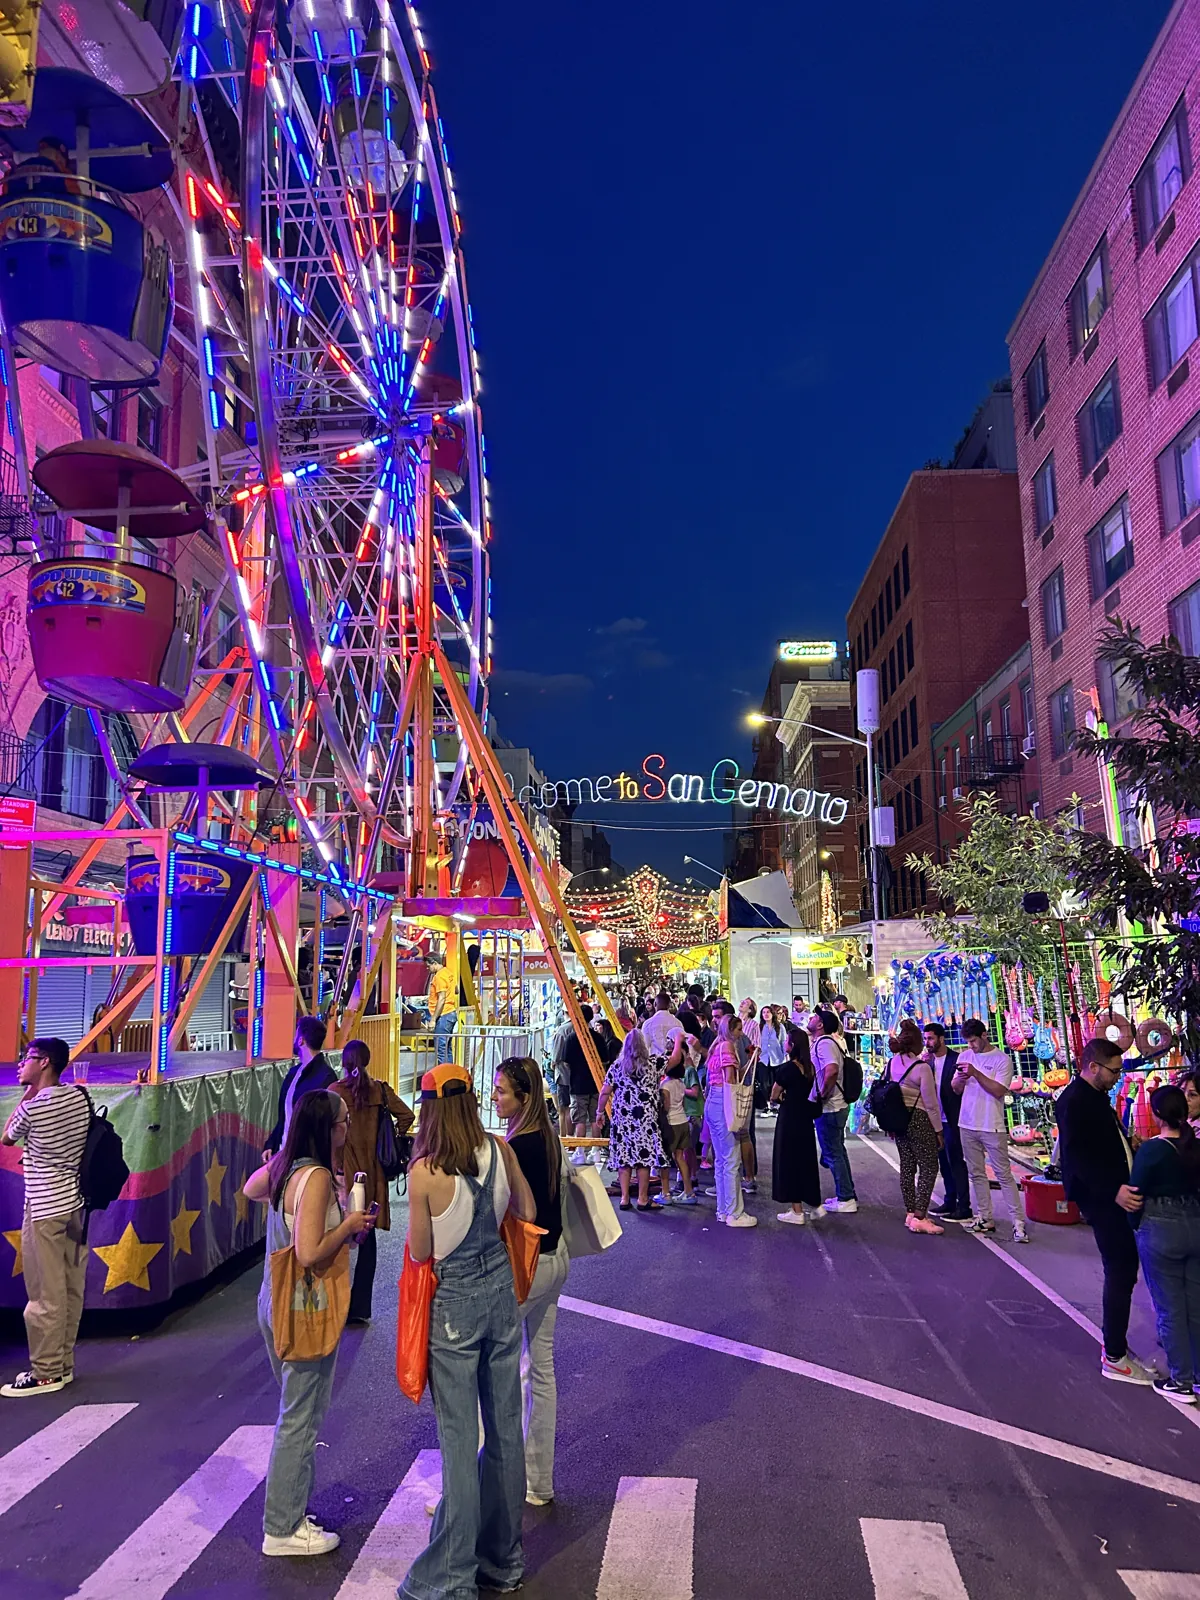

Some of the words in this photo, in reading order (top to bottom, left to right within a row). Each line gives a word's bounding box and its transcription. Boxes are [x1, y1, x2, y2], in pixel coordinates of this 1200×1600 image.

[61, 582, 76, 597] 12
[63, 568, 136, 594] WHEEL
[614, 771, 639, 800] to
[642, 753, 706, 803] San
[711, 758, 849, 825] Gennaro
[46, 922, 80, 943] LENDY
[797, 951, 834, 959] Basketball
